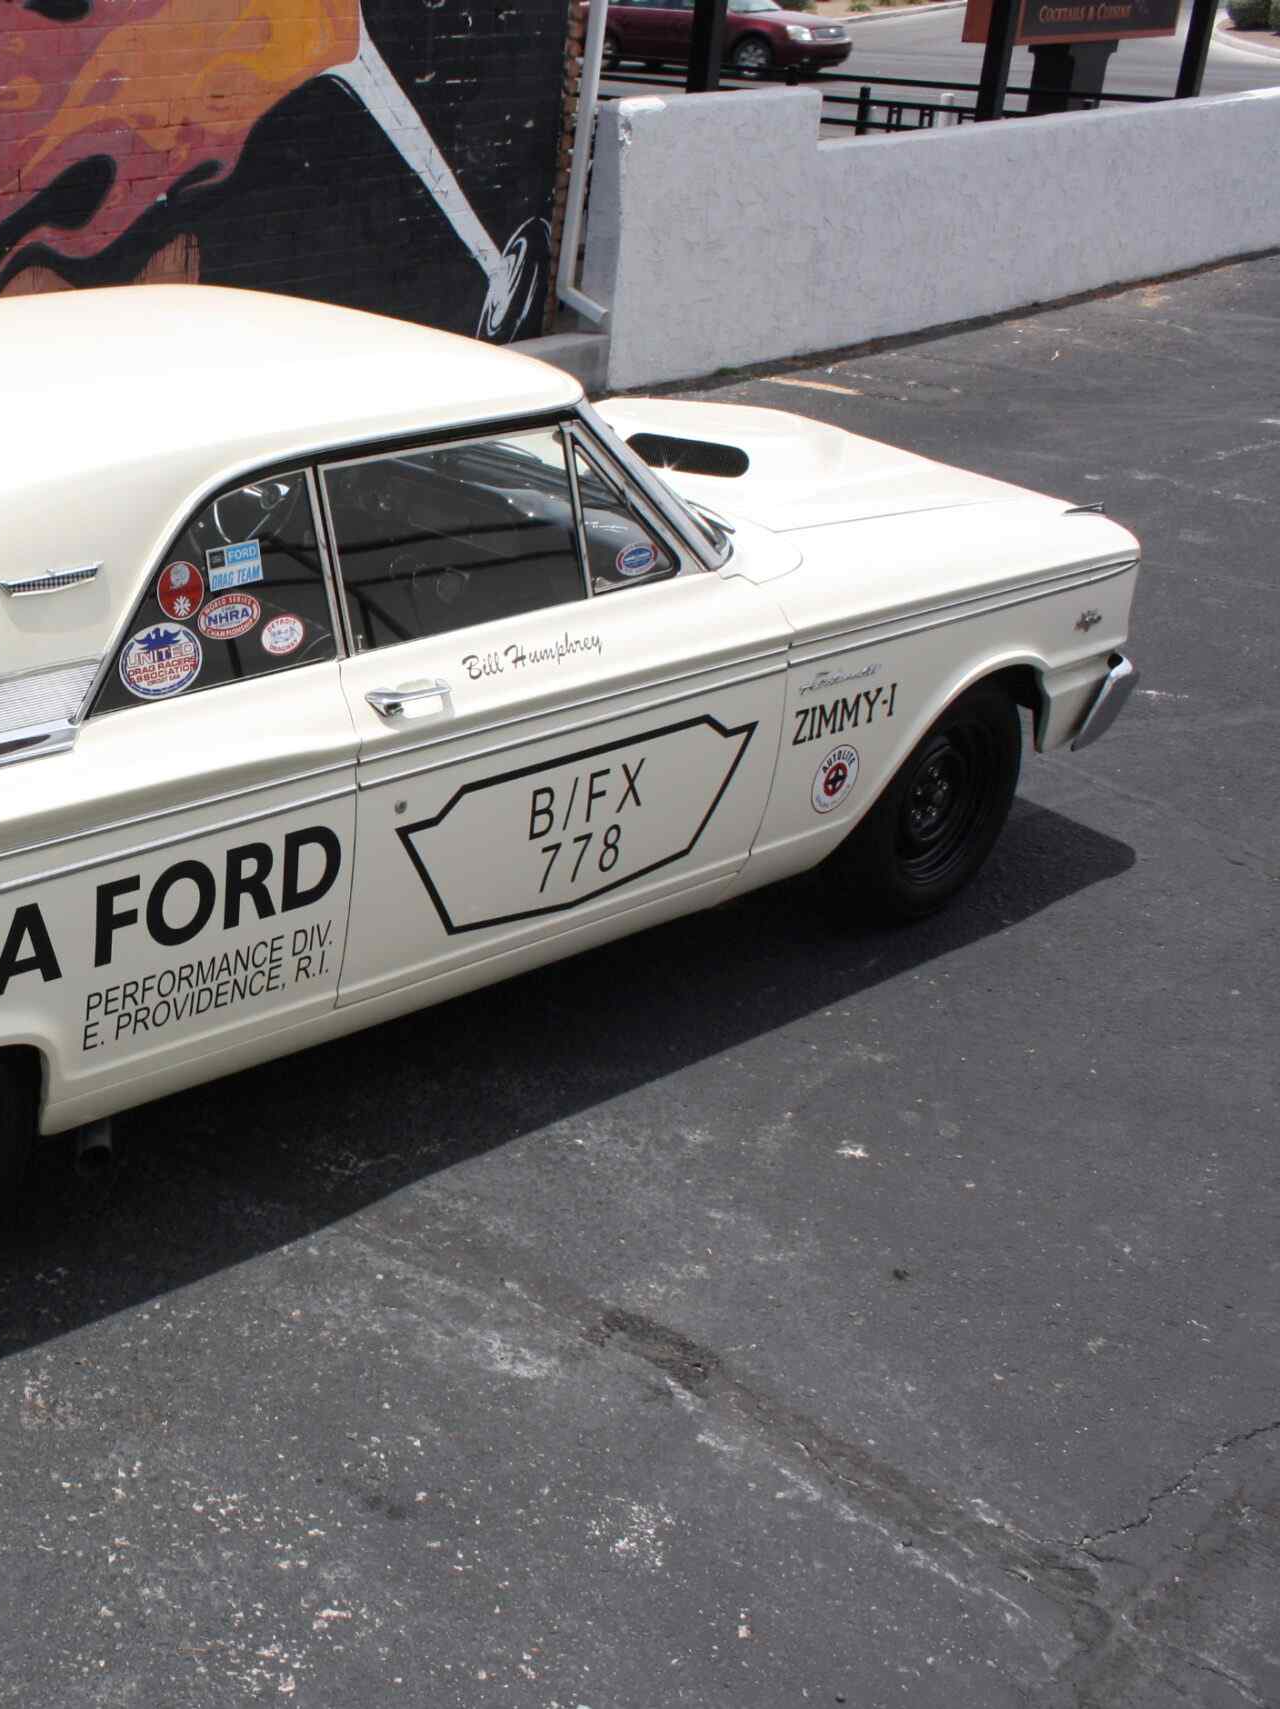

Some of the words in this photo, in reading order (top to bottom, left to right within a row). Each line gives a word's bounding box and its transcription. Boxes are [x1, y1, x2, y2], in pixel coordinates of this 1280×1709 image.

[227, 544, 256, 562] FORD
[211, 571, 235, 589] DRAG
[237, 564, 261, 585] TEAM
[207, 607, 250, 626] NHRA
[127, 641, 193, 668] UNITED
[128, 664, 156, 676] DRAG
[157, 655, 196, 670] RACERS
[462, 652, 504, 680] Bill
[504, 632, 603, 669] Humphrey
[128, 663, 196, 683] ASSOCIATION
[821, 749, 856, 775] AUTOLITE
[528, 757, 646, 841] B/FX
[539, 823, 622, 893] 778
[93, 824, 342, 969] FORD
[85, 933, 285, 1021] PERFORMANCE
[292, 919, 333, 957] DIV.
[81, 1021, 104, 1051] E.
[114, 963, 287, 1041] PROVIDENCE,
[295, 950, 330, 983] R.I.
